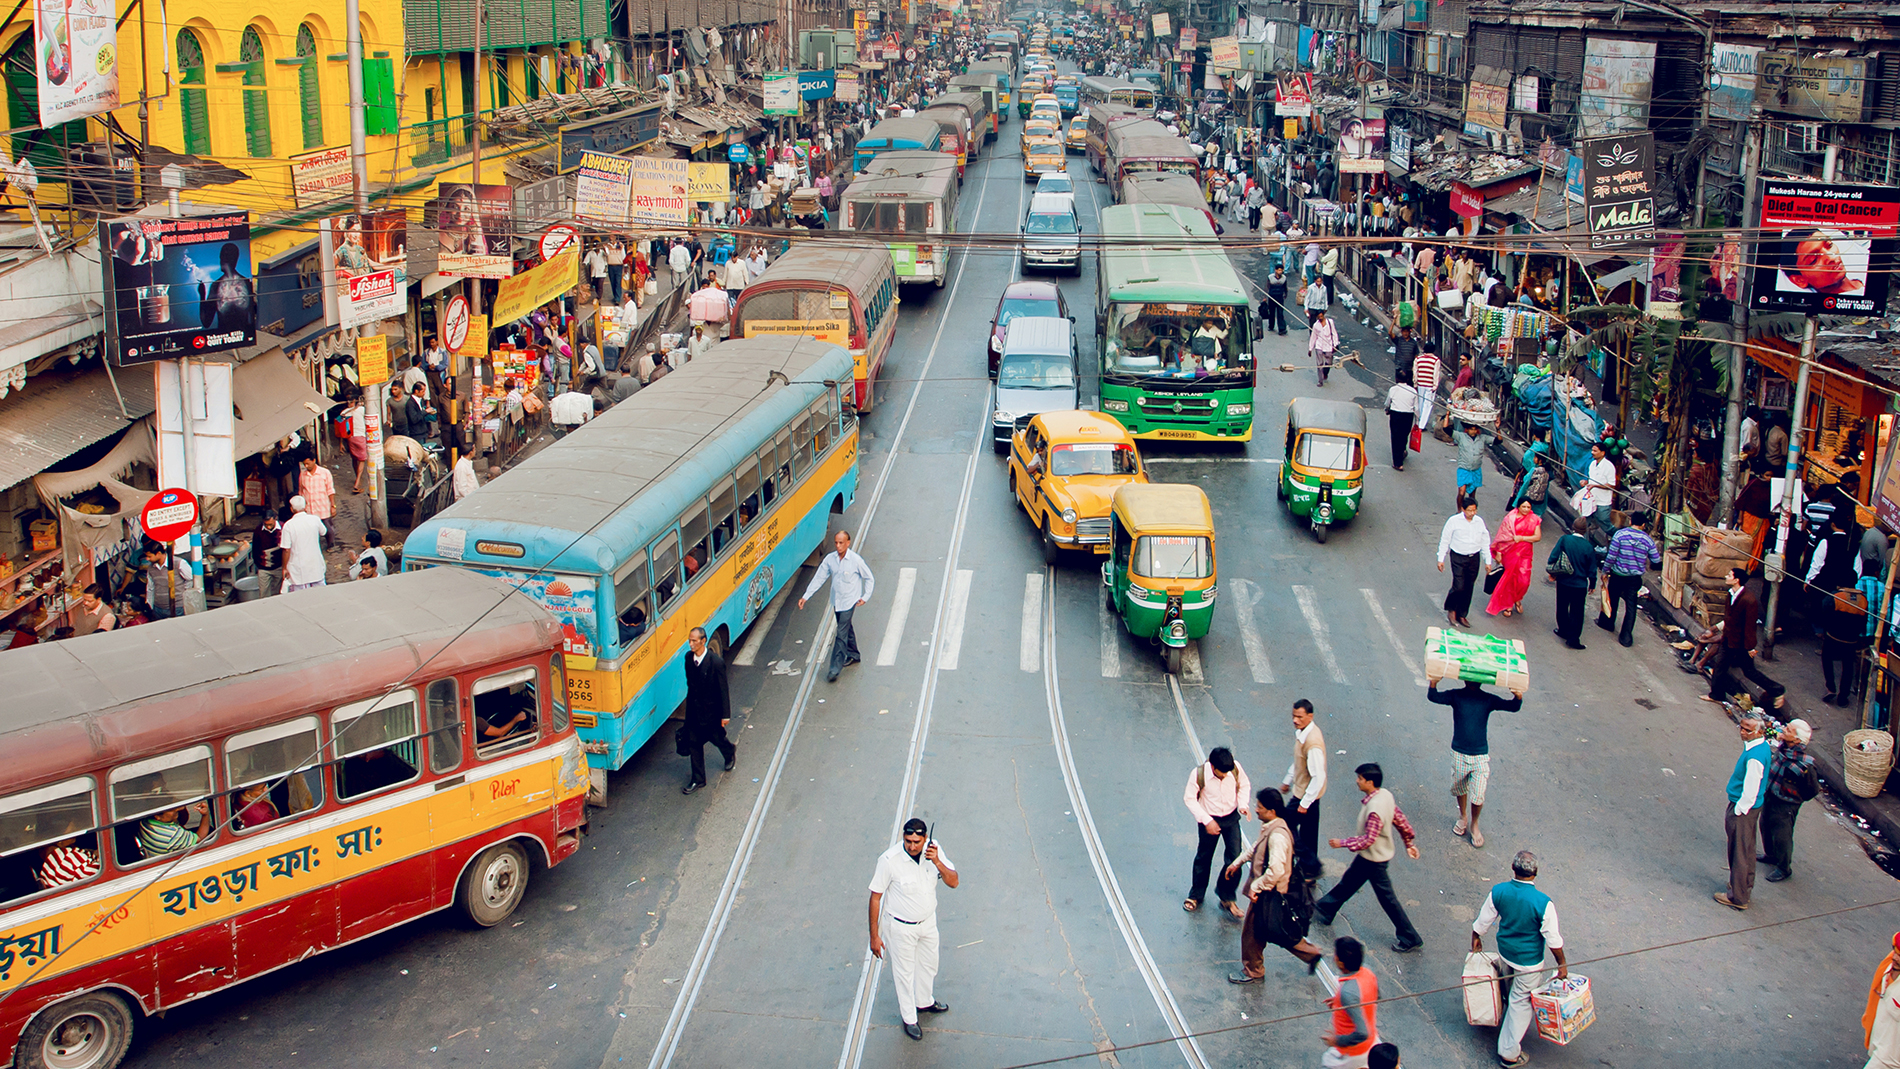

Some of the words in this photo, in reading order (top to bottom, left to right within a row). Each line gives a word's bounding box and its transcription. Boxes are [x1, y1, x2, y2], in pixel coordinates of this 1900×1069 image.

[798, 80, 828, 91] OKIA
[580, 152, 632, 177] ABHISHEK
[635, 159, 659, 170] ROYAL
[661, 161, 686, 172] TOUCH
[634, 171, 666, 181] CREATIONS
[300, 179, 325, 195] SARADA
[326, 172, 353, 188] TRADERS
[594, 180, 609, 188] HOUSE
[579, 191, 594, 199] DHOTI
[580, 185, 606, 195] EXCLUSIVE
[1769, 187, 1796, 196] Mukesh
[1797, 188, 1822, 197] Harane
[1823, 190, 1850, 199] 24-year
[1851, 191, 1863, 199] old
[637, 195, 683, 211] Raymond
[1767, 199, 1794, 212] Died
[1814, 202, 1838, 214] Oral
[1840, 203, 1883, 217] Cancer
[1595, 202, 1652, 231] Mala
[177, 221, 198, 232] lungs
[161, 234, 178, 245] that
[177, 233, 204, 244] causes
[204, 231, 229, 242] cancer
[351, 274, 392, 298] Ashok
[1853, 303, 1874, 311] TODAY
[826, 323, 840, 331] Sika
[207, 338, 223, 347] QUIT
[223, 335, 244, 344] TODAY
[159, 861, 261, 916] হাওড়া
